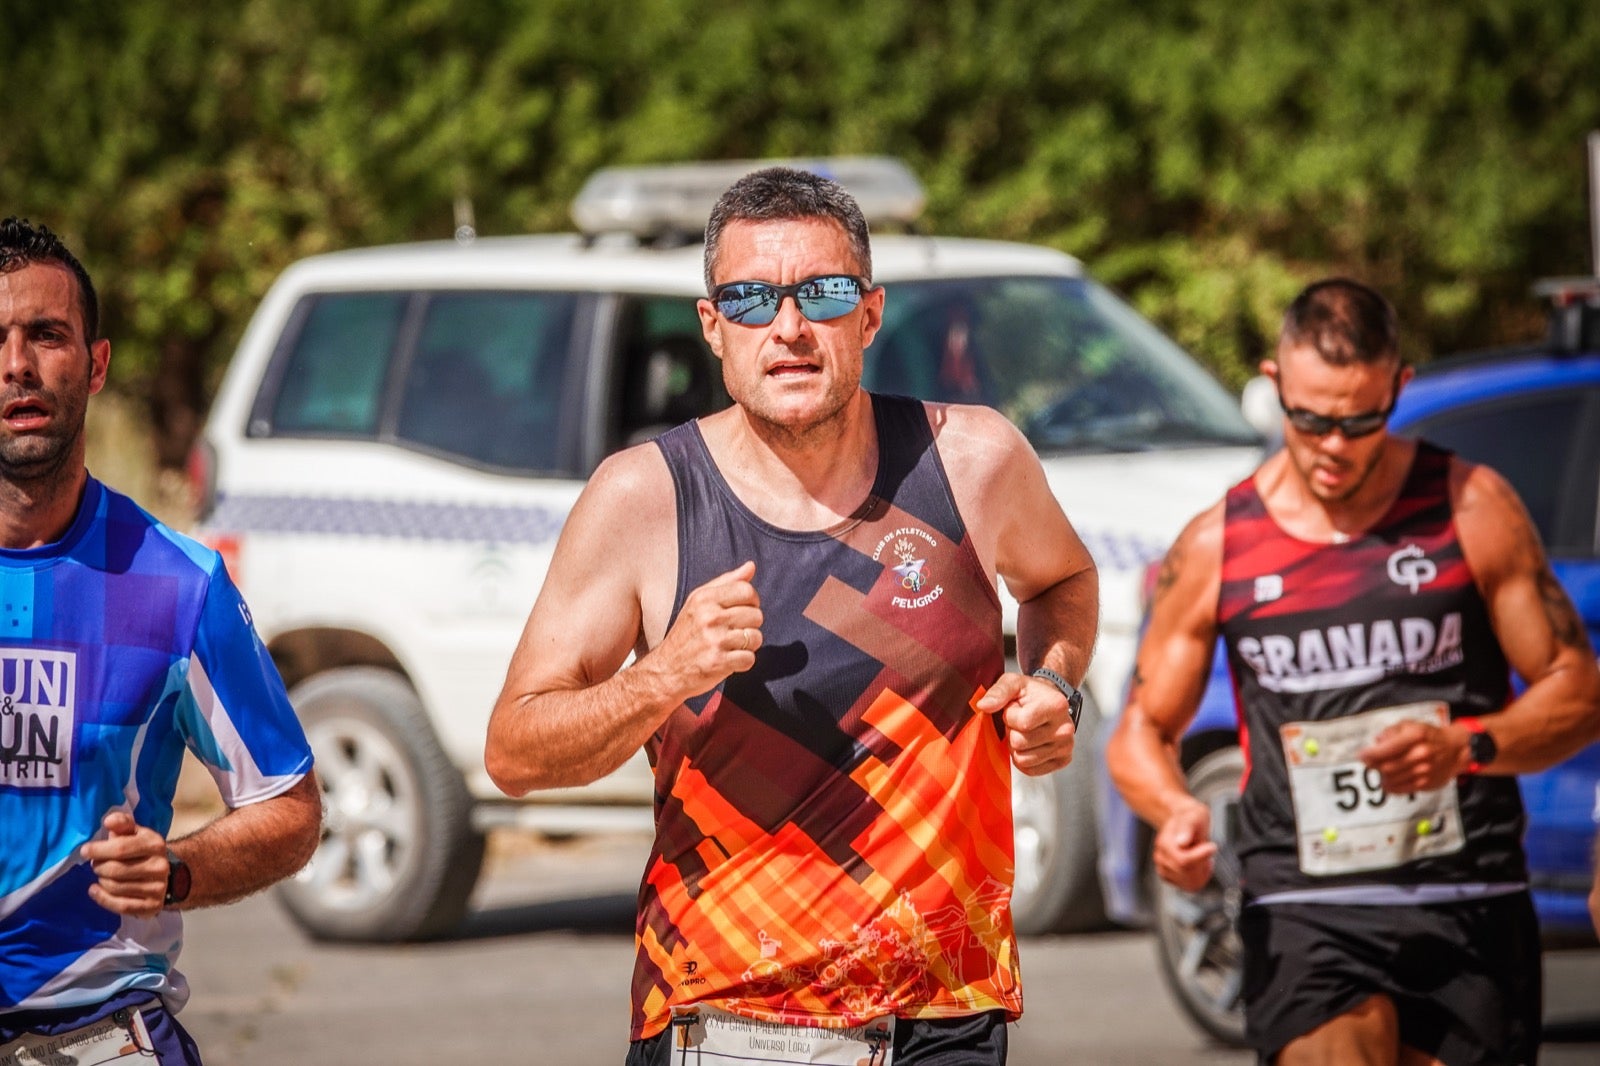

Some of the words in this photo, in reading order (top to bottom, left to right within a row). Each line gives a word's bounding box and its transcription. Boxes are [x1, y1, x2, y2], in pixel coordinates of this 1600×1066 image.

[872, 541, 886, 561] CLUB
[884, 533, 894, 543] DE
[895, 527, 937, 547] ATLETISMO
[891, 584, 944, 609] PELIGROS
[1237, 612, 1462, 677] GRANADA
[1, 696, 14, 716] &
[1332, 766, 1417, 812] 59
